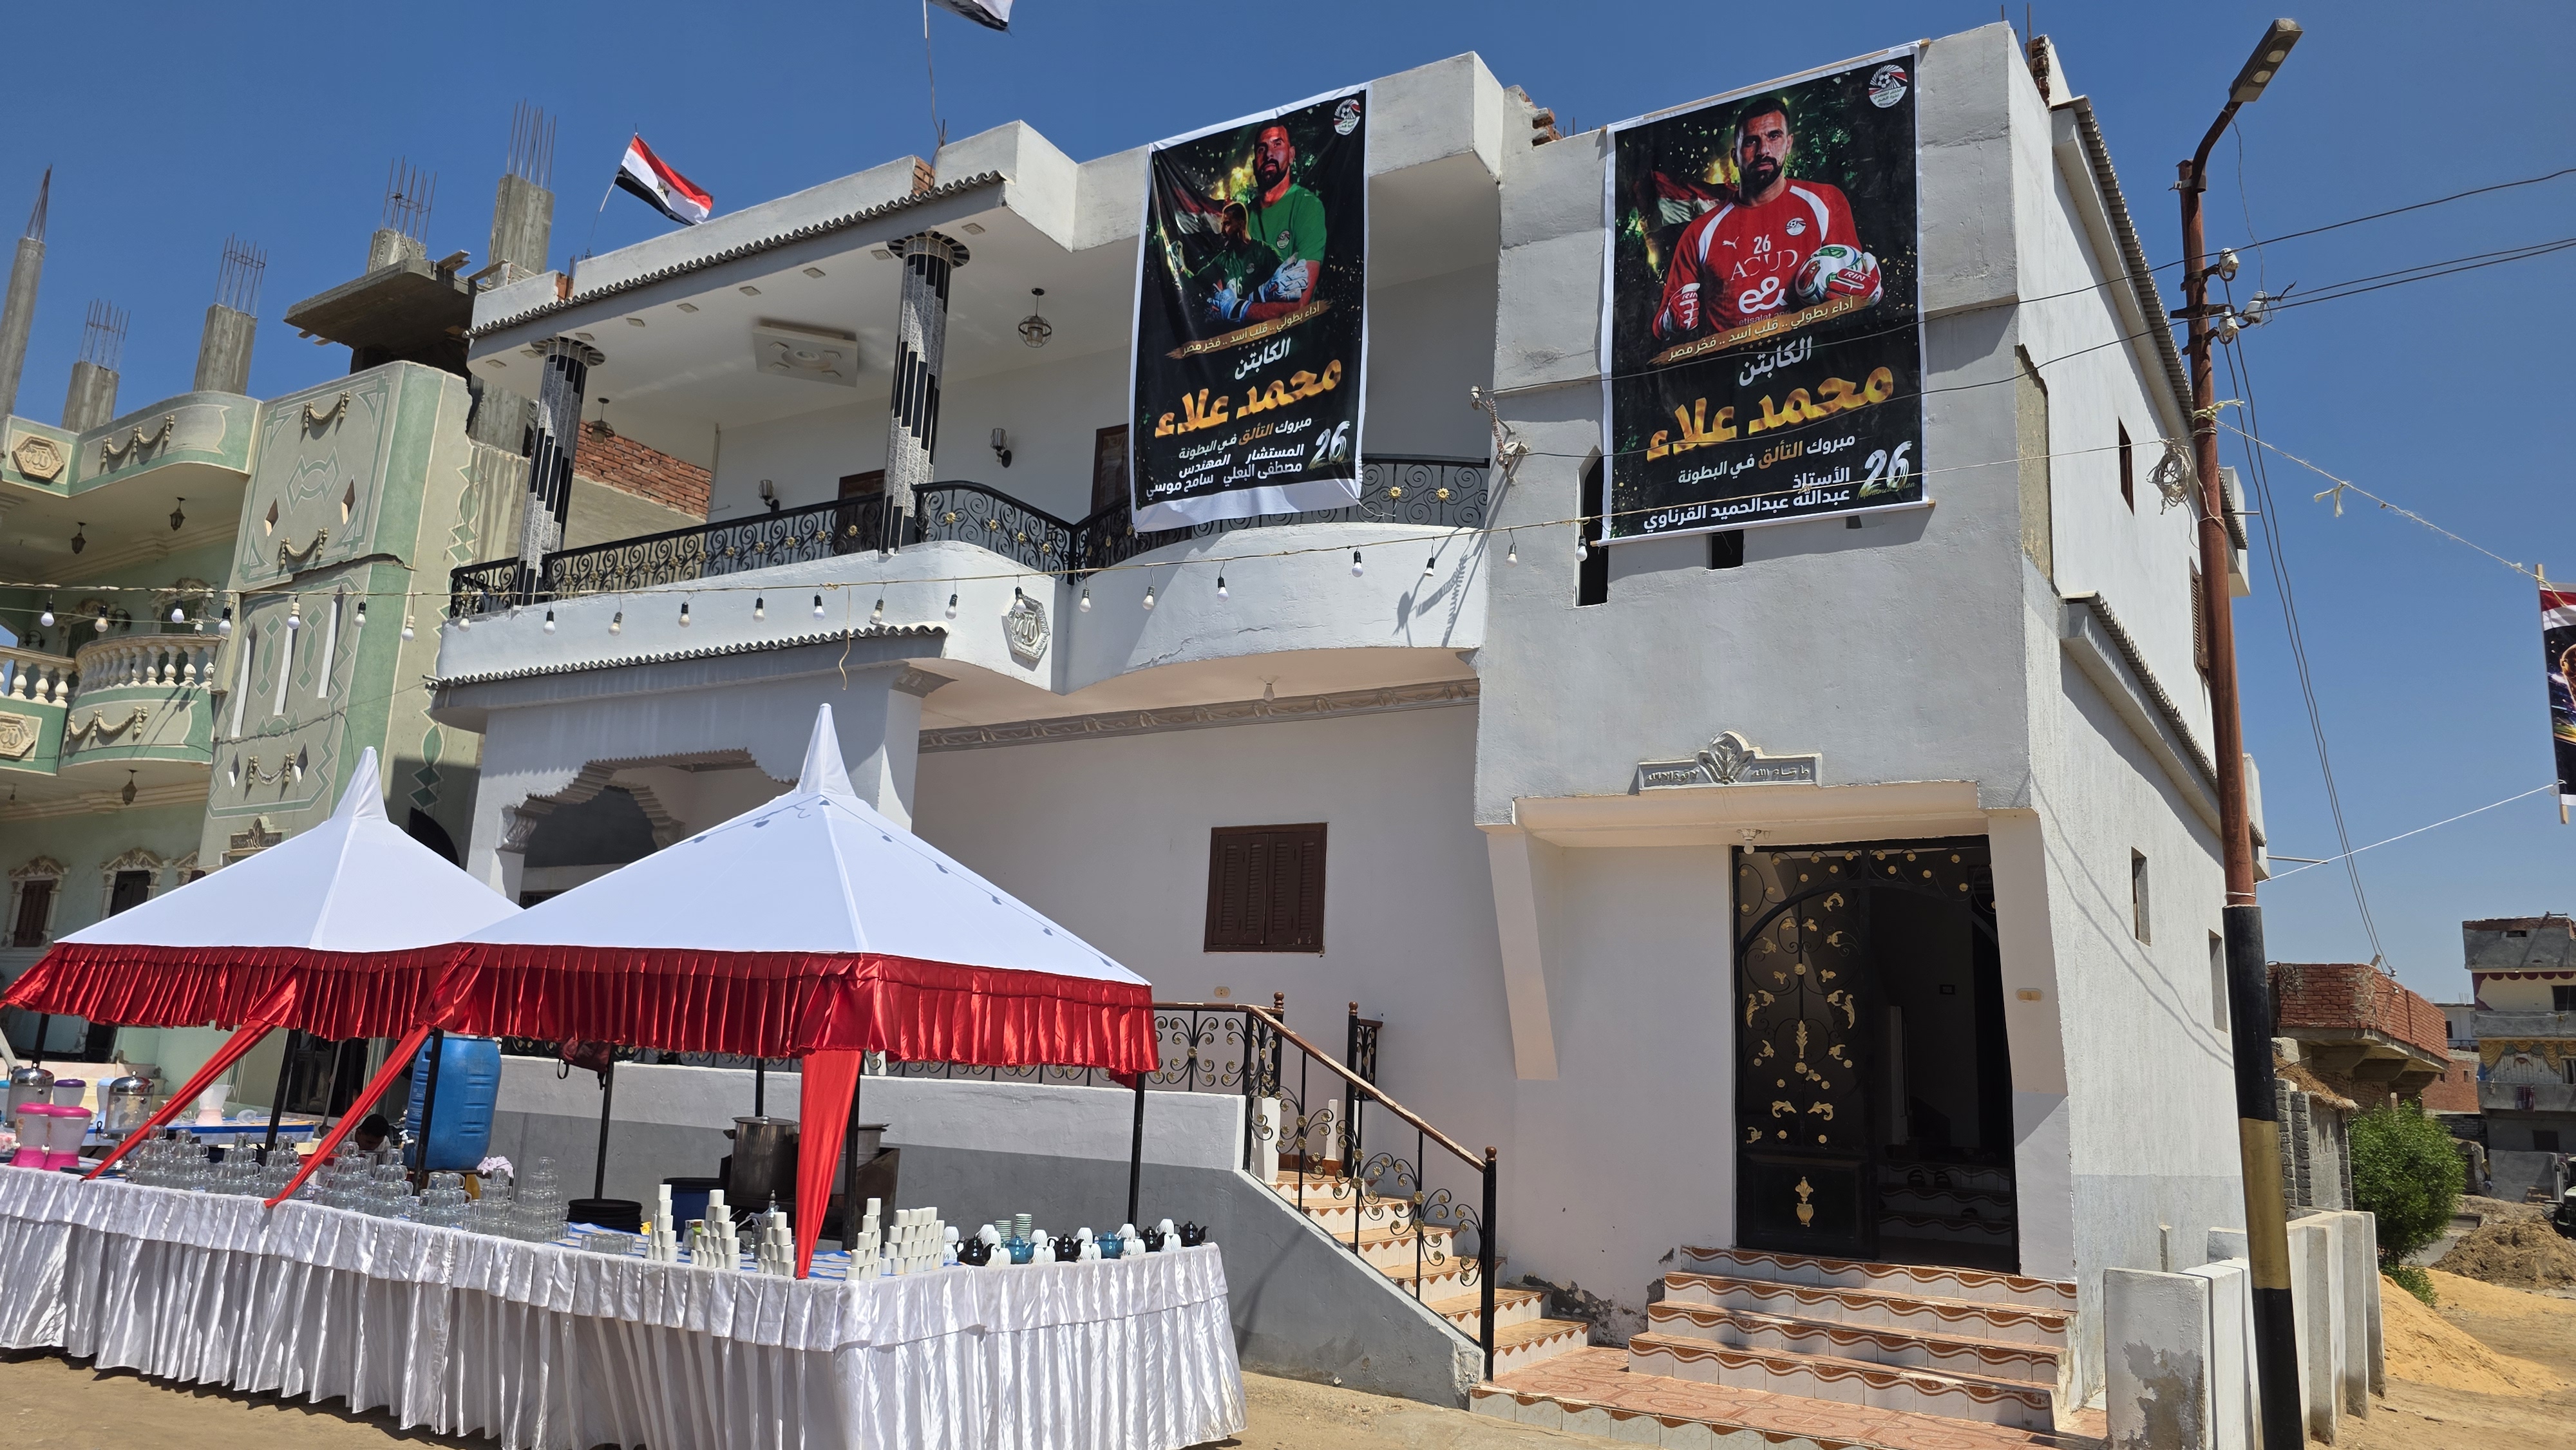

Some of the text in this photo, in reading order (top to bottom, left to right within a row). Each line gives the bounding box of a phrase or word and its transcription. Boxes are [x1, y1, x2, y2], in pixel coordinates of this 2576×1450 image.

[1754, 234, 1771, 254] 26
[1730, 249, 1798, 281] ACUD
[1844, 271, 1866, 281] RIN
[1305, 301, 1320, 317] أداء
[1832, 296, 1853, 314] أداء
[1276, 313, 1303, 332] بطولي
[1754, 319, 1779, 337] قلب
[1791, 308, 1828, 330] بطولي
[1230, 328, 1247, 343] أسد
[1249, 323, 1268, 339] قلب
[1728, 327, 1751, 343] أسد
[1182, 343, 1202, 357] مصر
[1202, 337, 1221, 352] فخر
[1668, 347, 1693, 362] مصر
[1694, 337, 1717, 355] فخر
[1235, 337, 1291, 380] الكابتن
[1739, 335, 1812, 386] الكابتن
[1154, 359, 1341, 438] محمد علاء
[1647, 366, 1894, 462] محمد علاء
[1179, 418, 1312, 460] مبروك التألق في البطونة
[1306, 420, 1350, 471] 26
[1245, 444, 1305, 464] المستشار
[1678, 435, 1855, 485] مبروك التألق في البطونة
[1179, 454, 1231, 478] المهندس
[1257, 461, 1302, 479] مصطفى
[1857, 440, 1912, 500] 26
[1184, 474, 1214, 492] سامح
[1792, 467, 1850, 489] الأستاذ
[1710, 497, 1789, 520] عبدالحميد
[1643, 505, 1707, 533] القرناوي
